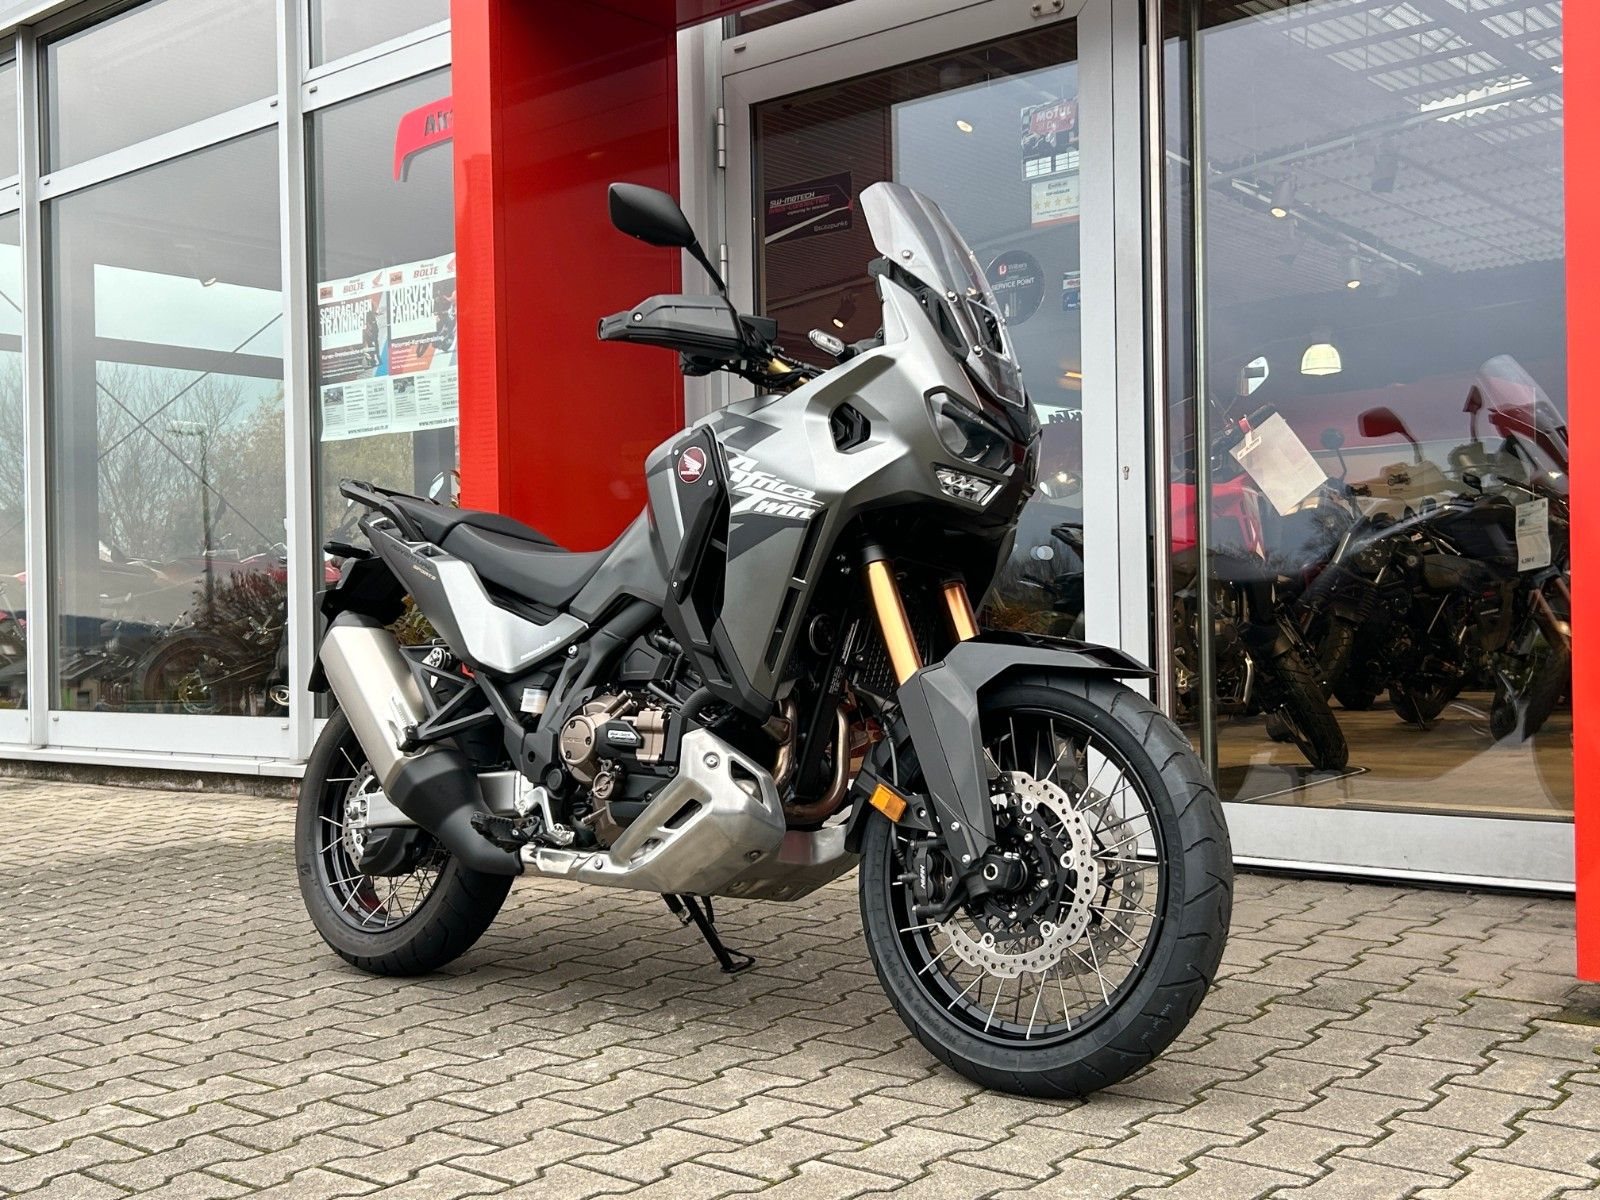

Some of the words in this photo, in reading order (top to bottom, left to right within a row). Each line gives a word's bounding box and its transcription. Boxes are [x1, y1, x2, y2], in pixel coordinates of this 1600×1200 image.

[424, 108, 453, 136] Air
[1036, 105, 1072, 122] MOTUL
[413, 265, 438, 279] BOLTE
[991, 281, 1016, 291] SERVICE
[1017, 277, 1035, 286] POINT
[343, 282, 364, 294] BOLTE
[390, 281, 434, 309] KURVEN
[320, 299, 373, 322] SCHRÄGLAGEN
[391, 299, 435, 325] FAHREN!
[321, 311, 367, 336] TRAINING!
[729, 454, 816, 499] Africa
[731, 486, 824, 519] Twin
